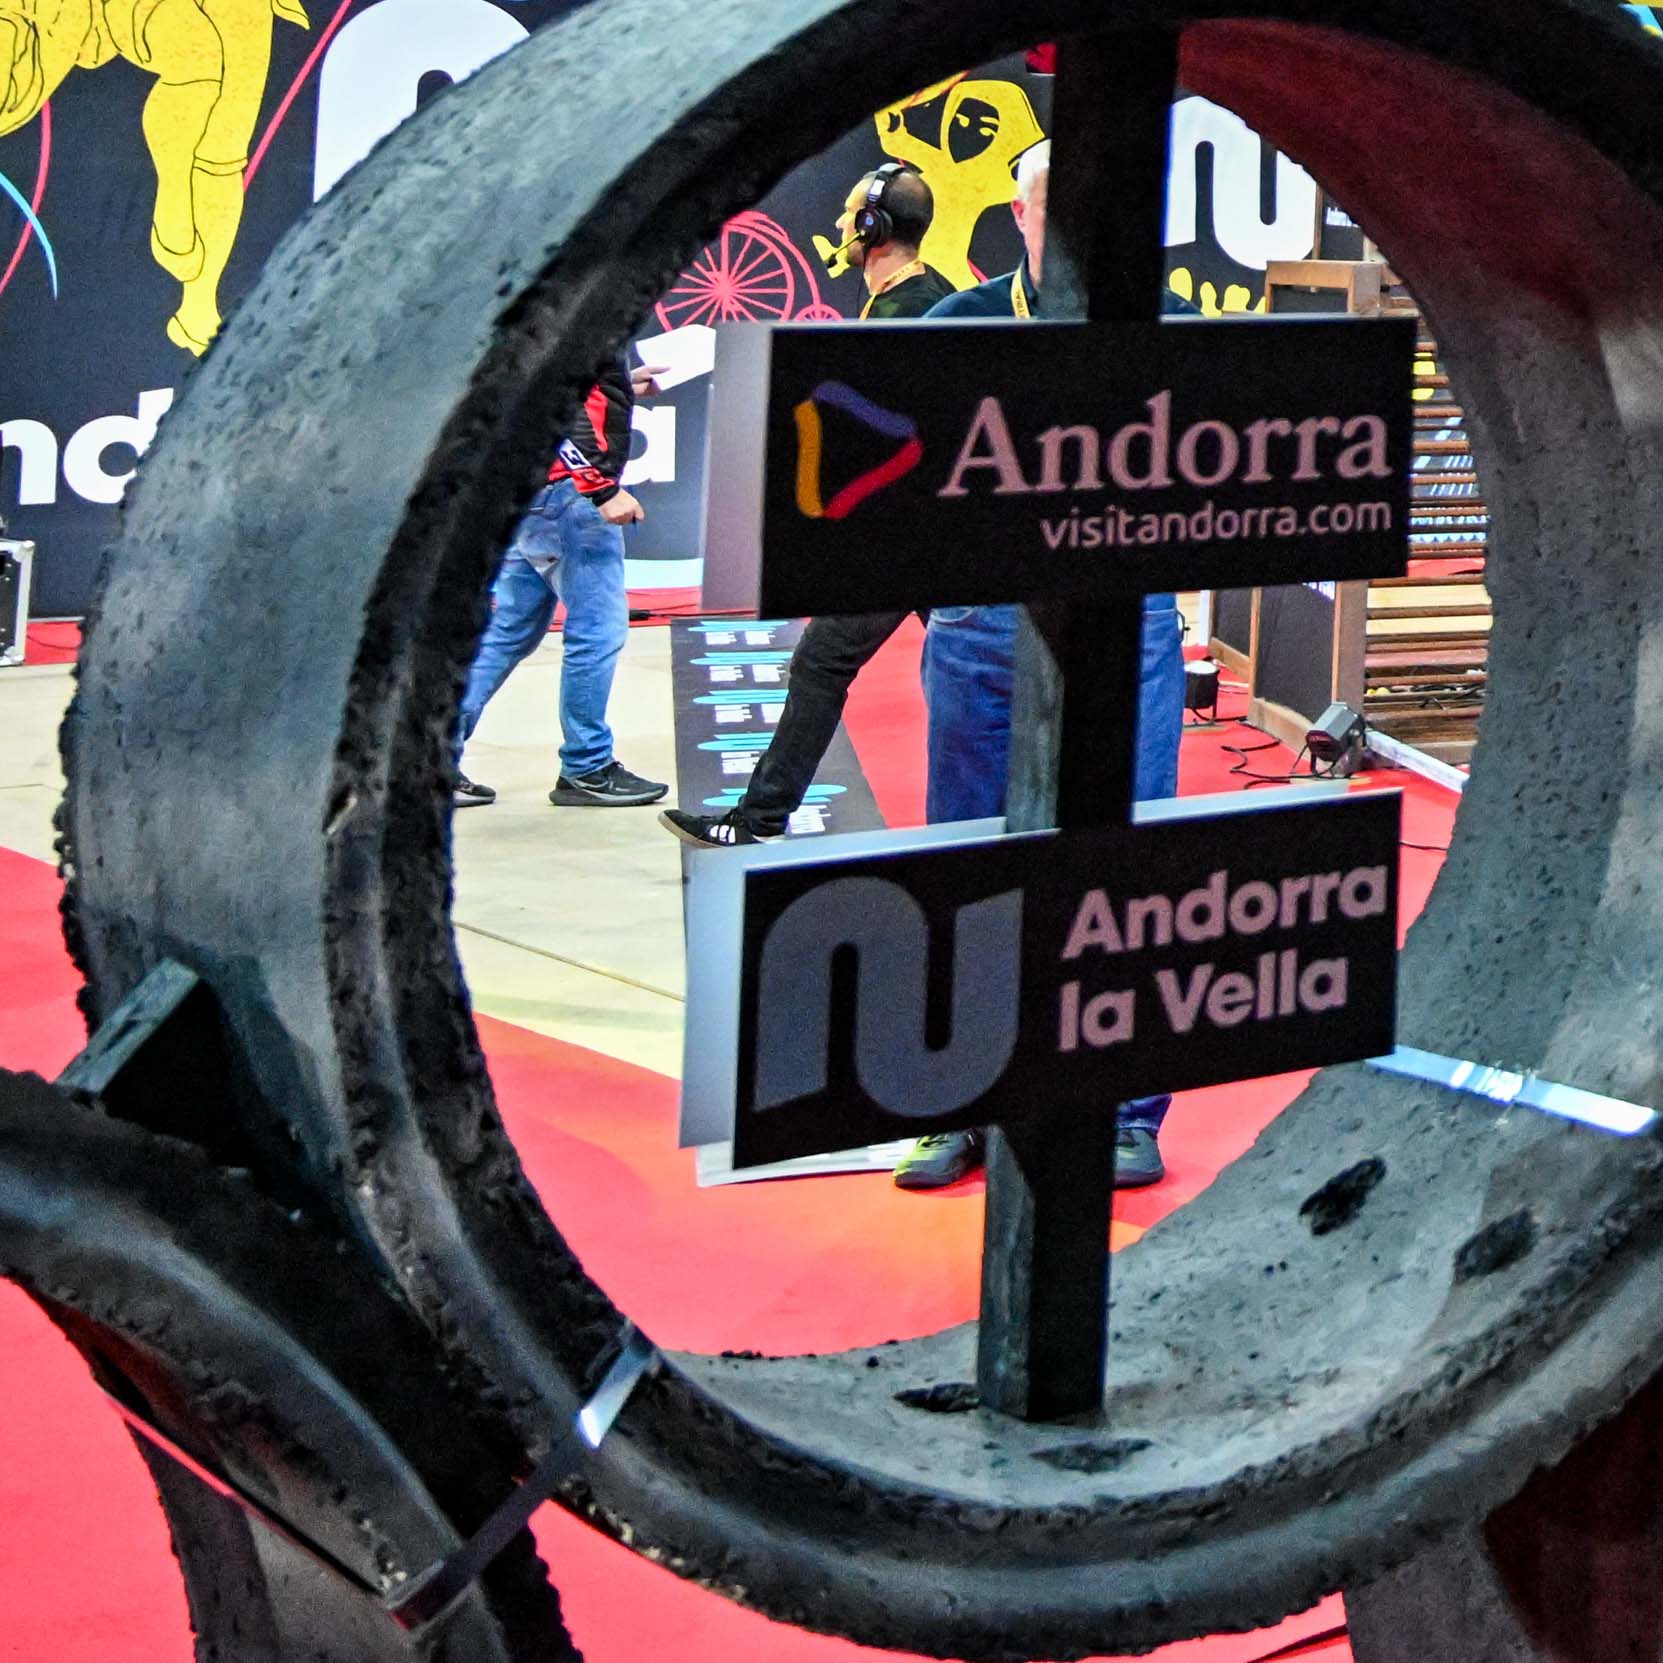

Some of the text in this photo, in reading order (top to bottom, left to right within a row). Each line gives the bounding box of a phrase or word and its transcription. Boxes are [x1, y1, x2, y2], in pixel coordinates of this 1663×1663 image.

[936, 390, 1392, 499] Andorra
[1041, 499, 1392, 552] visitandorra.com
[1061, 864, 1387, 960] Andorra
[1057, 947, 1348, 1053] la Vella
